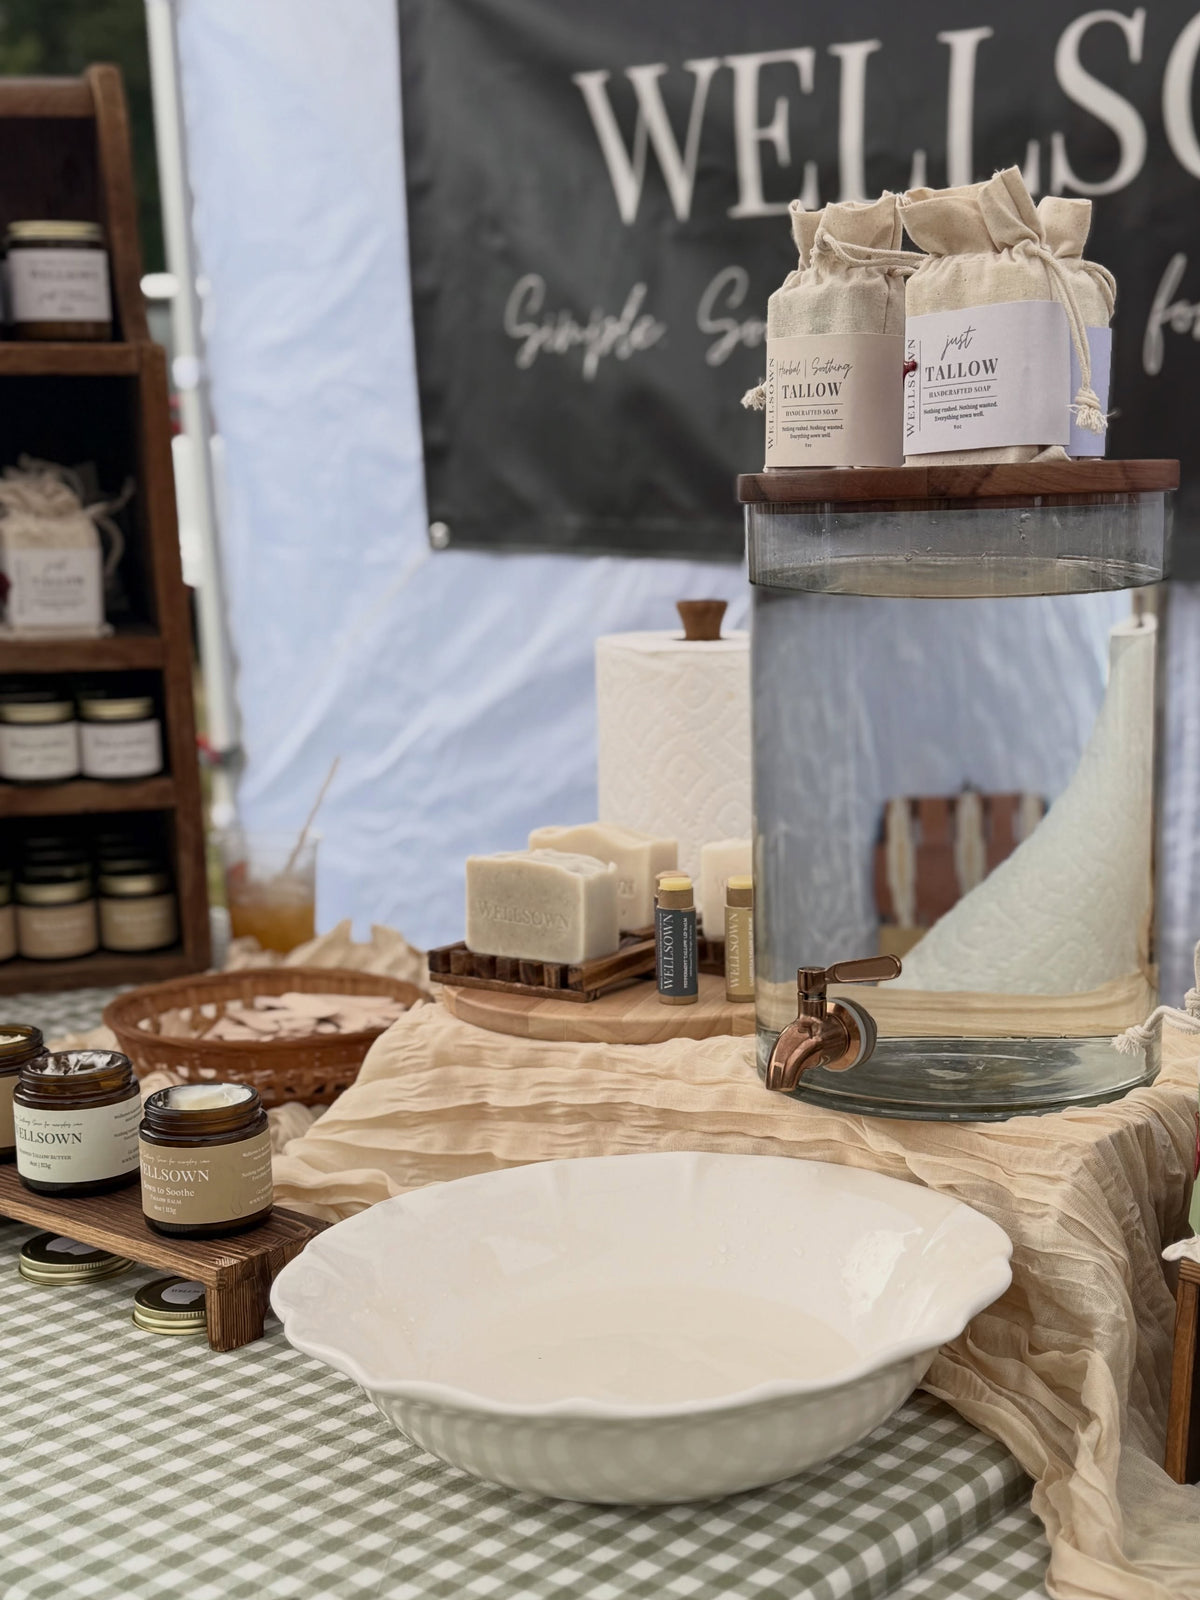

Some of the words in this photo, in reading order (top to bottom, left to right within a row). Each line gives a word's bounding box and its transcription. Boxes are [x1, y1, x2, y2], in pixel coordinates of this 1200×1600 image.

[503, 273, 667, 382] Simple
[941, 326, 977, 361] just
[779, 360, 801, 377] Herbal
[811, 357, 853, 379] Soothing
[925, 358, 999, 382] TALLOW
[781, 382, 843, 400] TALLOW
[928, 387, 973, 398] HANDCRAFTED
[974, 385, 992, 393] SOAP
[767, 358, 775, 449] WELLSOWN
[785, 409, 822, 417] HANDCRAFTED
[959, 403, 979, 411] Nothing
[934, 414, 960, 422] Everything
[478, 901, 571, 933] WELLSOWN
[663, 913, 674, 989] WELLSOWN
[728, 912, 740, 988] WELLSOWN
[157, 1186, 165, 1194] to
[166, 1187, 195, 1197] Soothe
